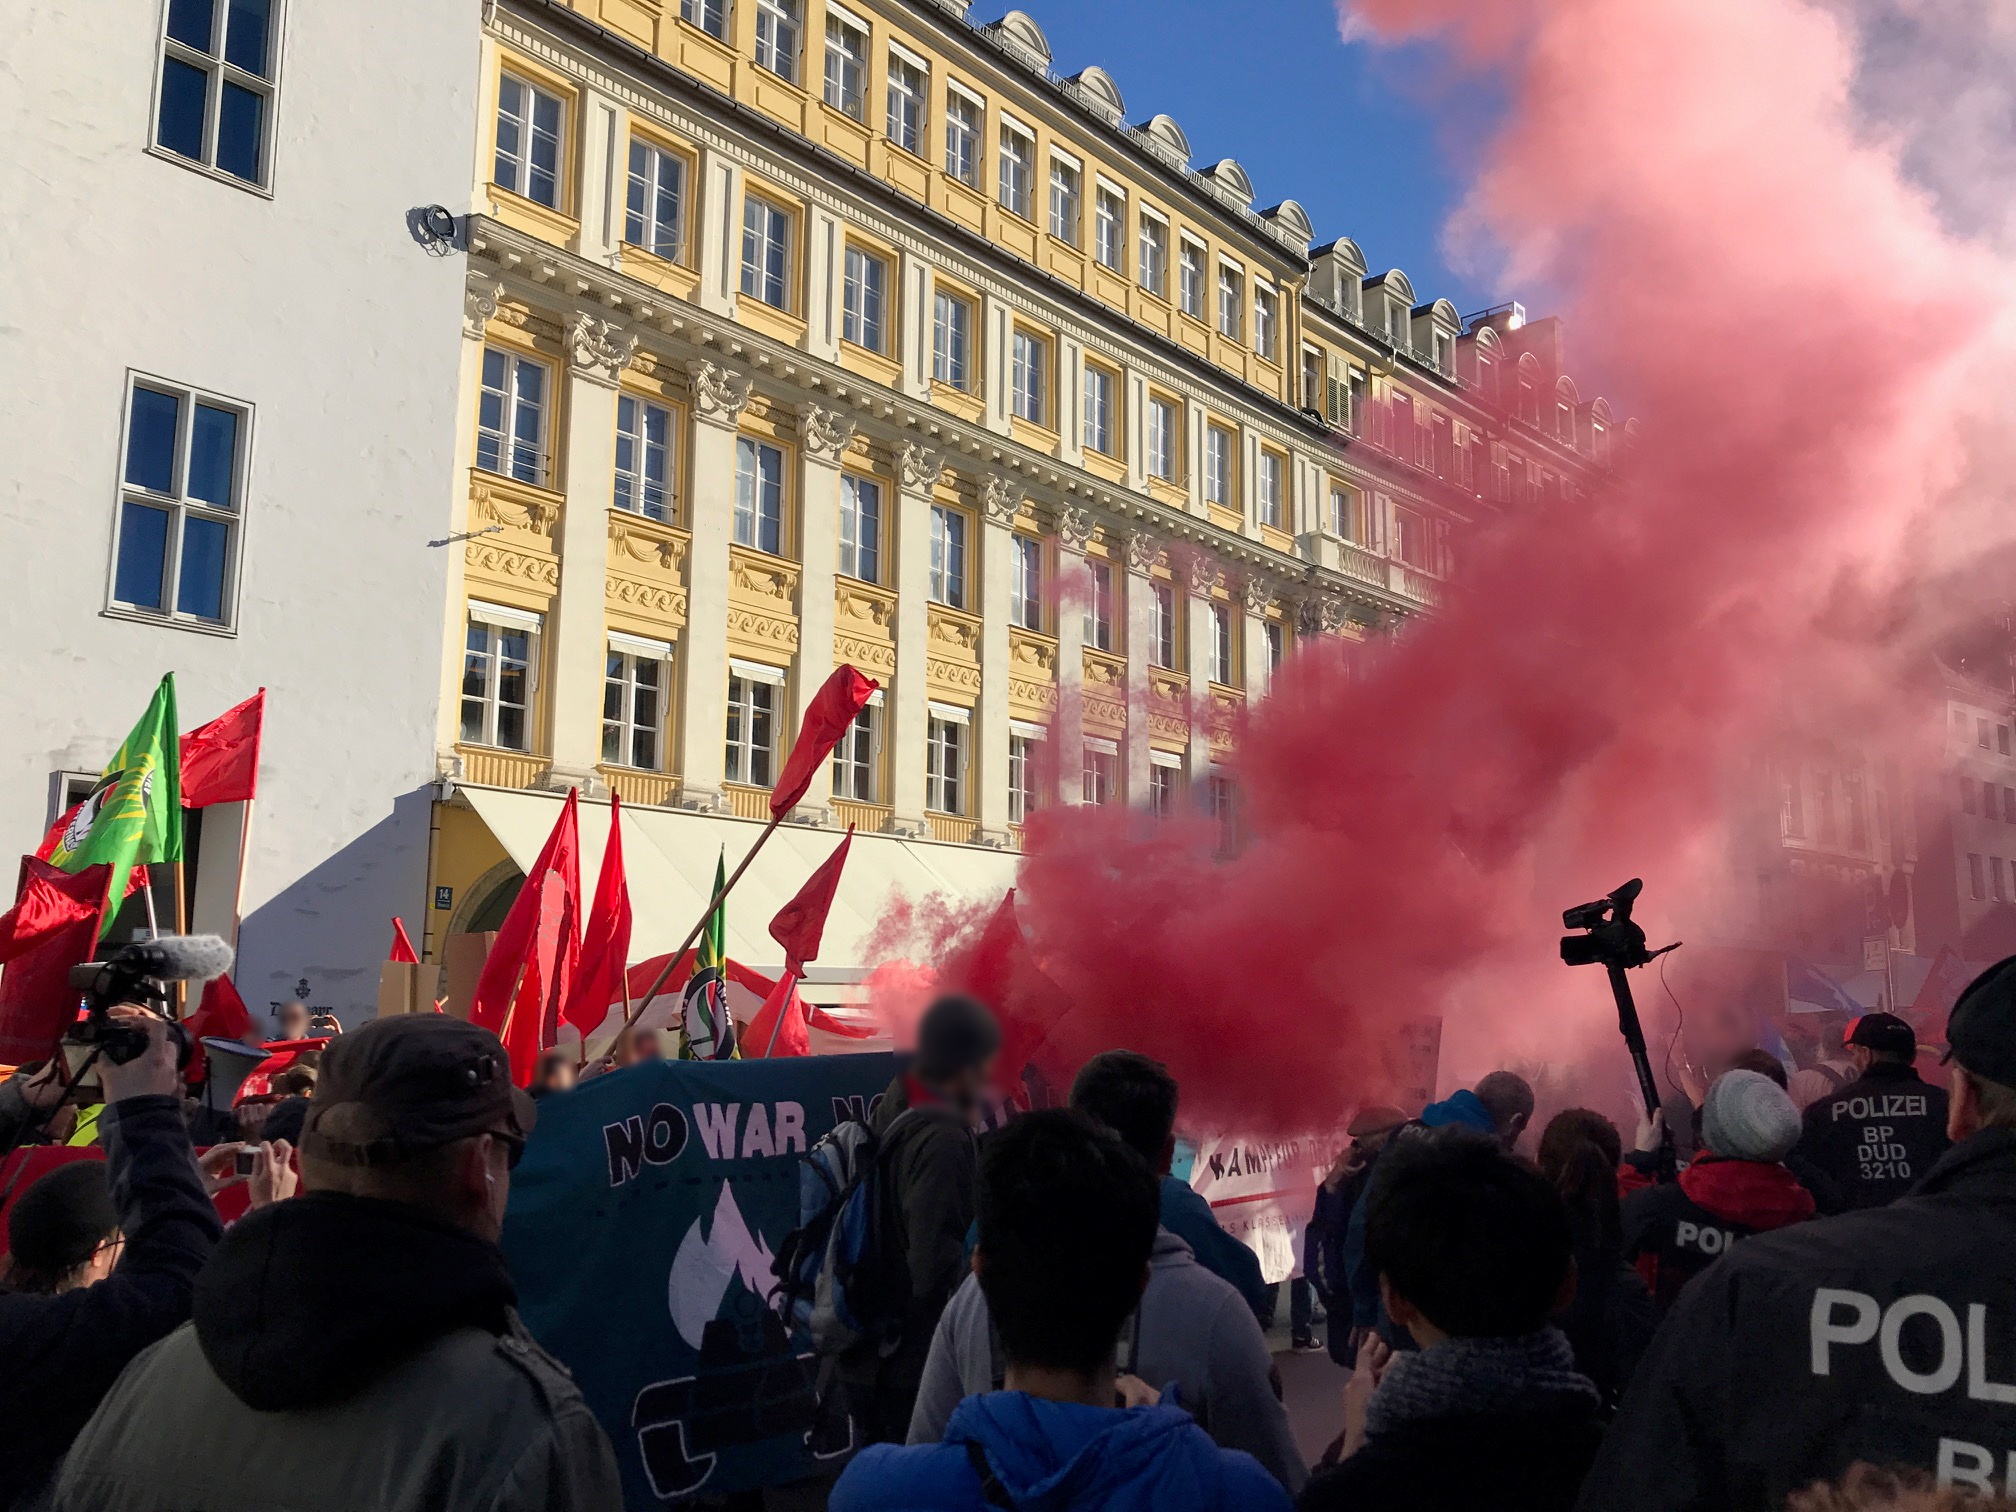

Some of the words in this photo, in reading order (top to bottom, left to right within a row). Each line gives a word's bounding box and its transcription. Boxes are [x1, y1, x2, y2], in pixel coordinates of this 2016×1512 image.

[439, 888, 450, 900] 14
[1832, 1095, 1928, 1122] POLIZEI
[603, 1102, 689, 1187] NO
[692, 1100, 806, 1160] WAR
[1863, 1125, 1895, 1144] BP
[1857, 1142, 1908, 1162] DUD
[1860, 1161, 1912, 1180] 3210
[1810, 1287, 2016, 1404] POL
[1937, 1437, 2016, 1499] B
